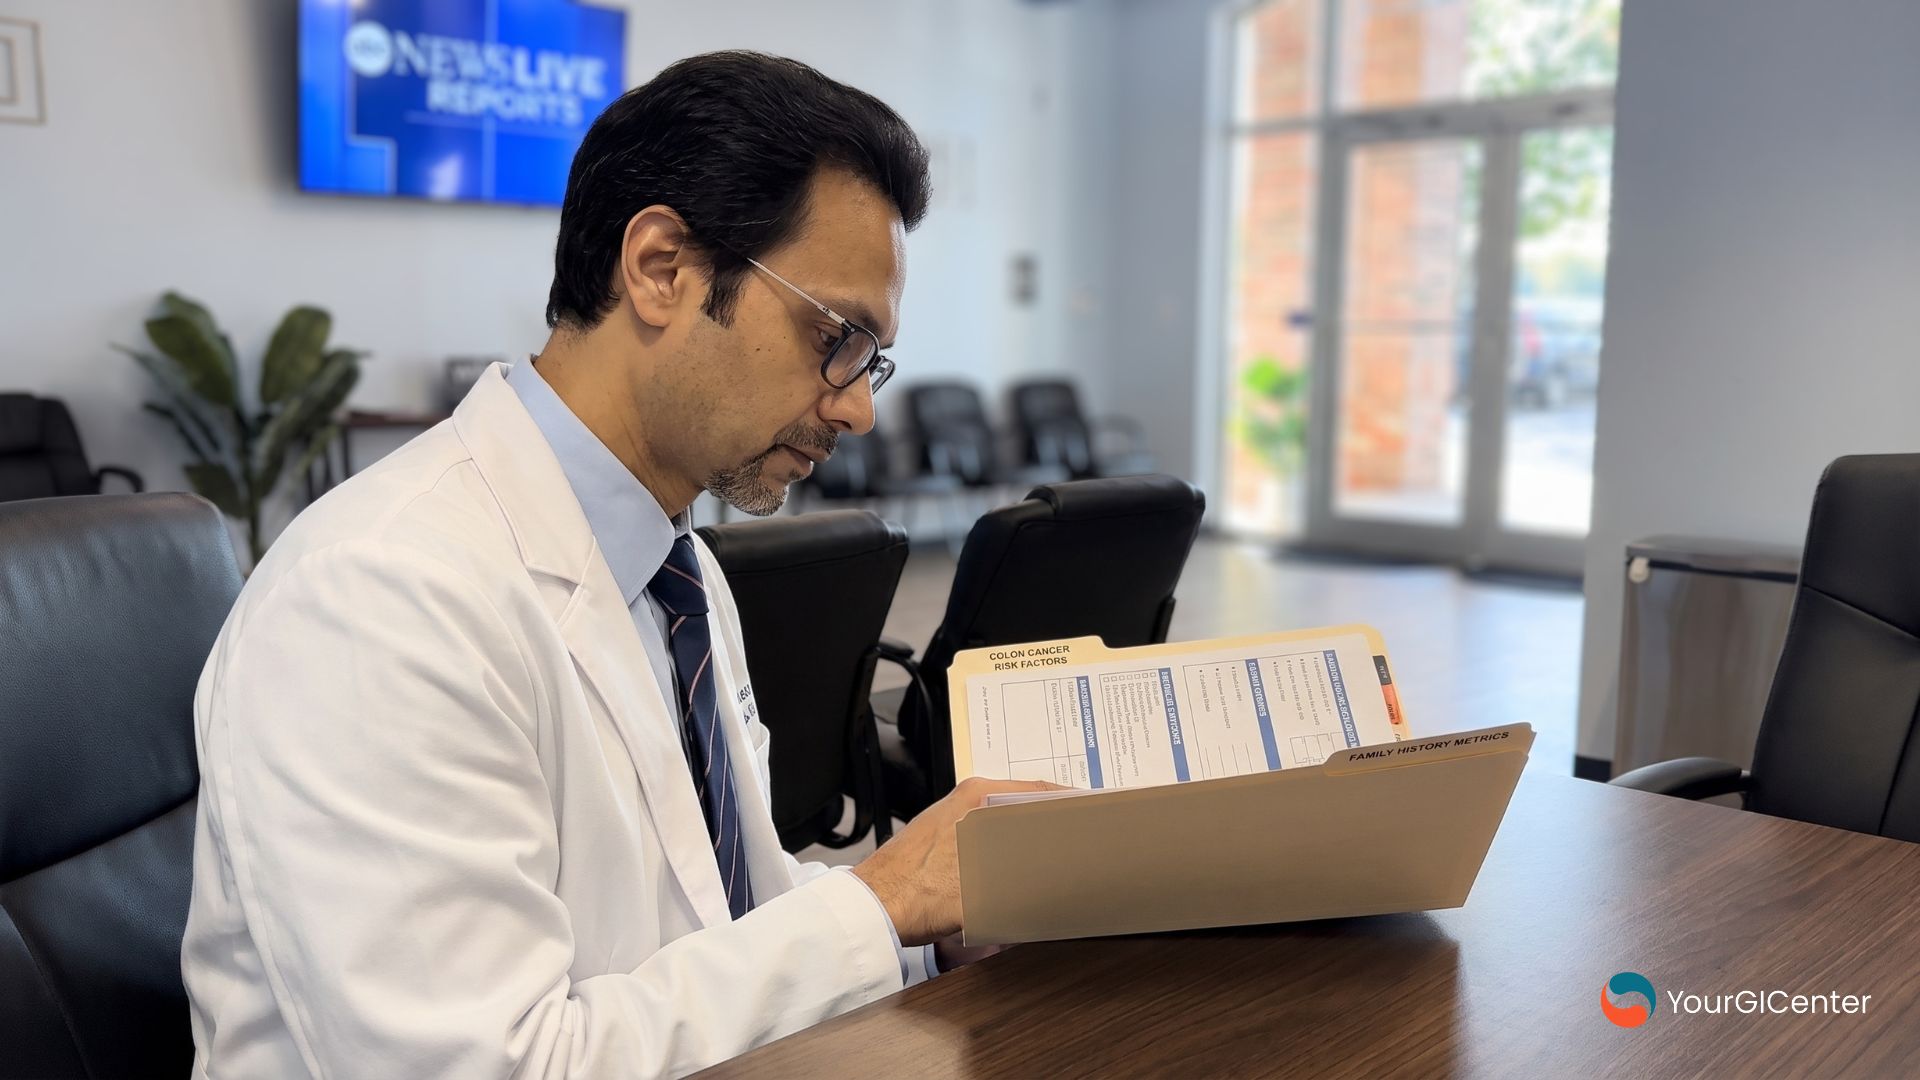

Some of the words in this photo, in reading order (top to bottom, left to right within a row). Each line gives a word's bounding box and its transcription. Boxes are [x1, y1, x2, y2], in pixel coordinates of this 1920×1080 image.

[394, 31, 513, 81] NEWS
[514, 49, 606, 98] LIVE
[426, 80, 583, 125] REPORTS
[989, 650, 1025, 661] COLON
[1027, 645, 1070, 657] CANCER
[994, 661, 1018, 671] RISK
[1020, 656, 1068, 668] FACTORS
[1349, 749, 1394, 762] FAMILY
[1397, 740, 1451, 755] HISTORY
[1453, 731, 1510, 746] METRICS
